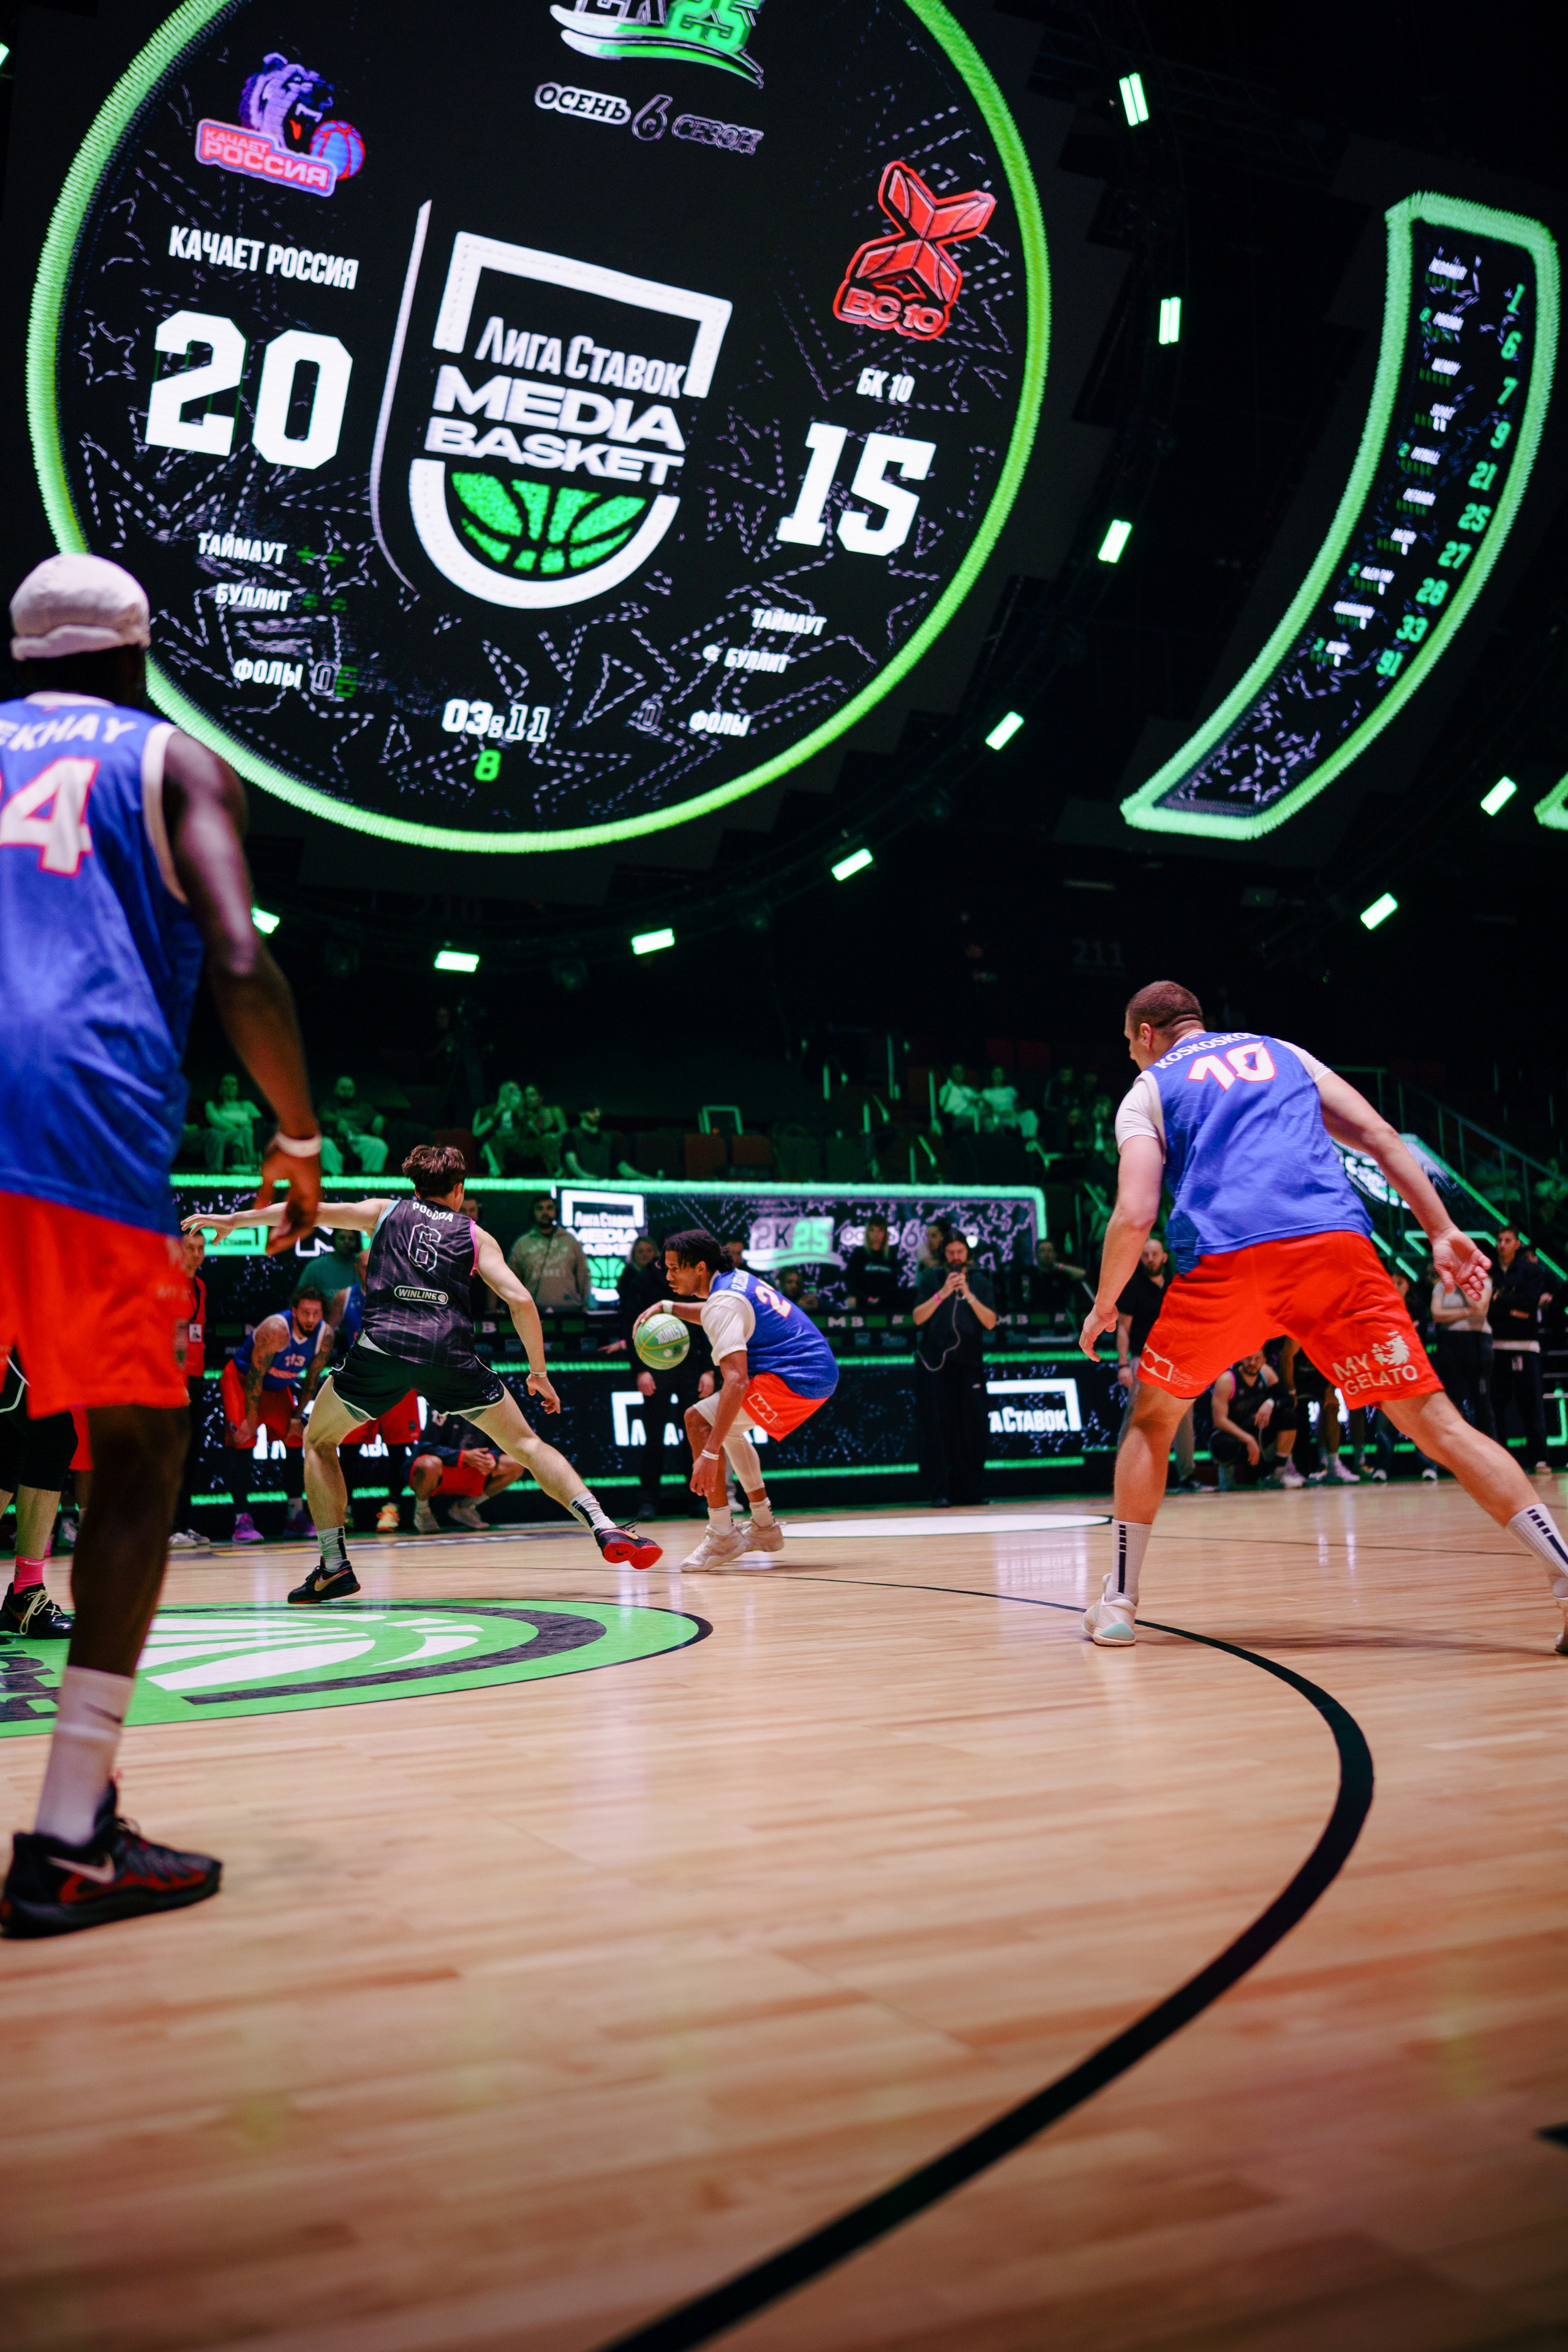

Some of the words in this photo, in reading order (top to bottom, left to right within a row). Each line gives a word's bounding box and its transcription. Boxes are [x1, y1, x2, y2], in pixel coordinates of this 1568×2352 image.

[538, 85, 627, 120] ОСЕНЬ
[631, 94, 673, 141] 6
[203, 140, 329, 188] РОССИЯ
[168, 225, 266, 271] КАЧАЕТ
[265, 243, 360, 290] РОССИЯ
[1501, 331, 1523, 360] 6
[145, 310, 353, 470] 20
[856, 368, 884, 398] БК
[888, 374, 915, 403] 10
[432, 364, 686, 451] MEDIA
[1490, 421, 1512, 449] 9
[426, 417, 685, 486] BASKET
[776, 422, 937, 557] 15
[1468, 461, 1498, 491] 21
[1457, 502, 1492, 533] 25
[198, 532, 288, 565] ТАЙМАУТ
[1437, 540, 1472, 570] 27
[214, 582, 293, 612] БУЛЛИТ
[1415, 577, 1449, 606] 28
[752, 608, 827, 636] ТАЙМАУТ
[233, 658, 304, 688] ФОЛЫ
[1375, 650, 1404, 677] 91
[442, 698, 551, 743] 03:11
[689, 710, 752, 737] ФОЛЫ
[474, 749, 502, 782] 8
[1186, 1041, 1277, 1092] 10
[412, 1201, 454, 1223] POGODA
[408, 1223, 442, 1272] 6
[399, 1288, 437, 1300] WINLINE
[1332, 1353, 1371, 1381] MY
[1344, 1365, 1419, 1395] GELATO
